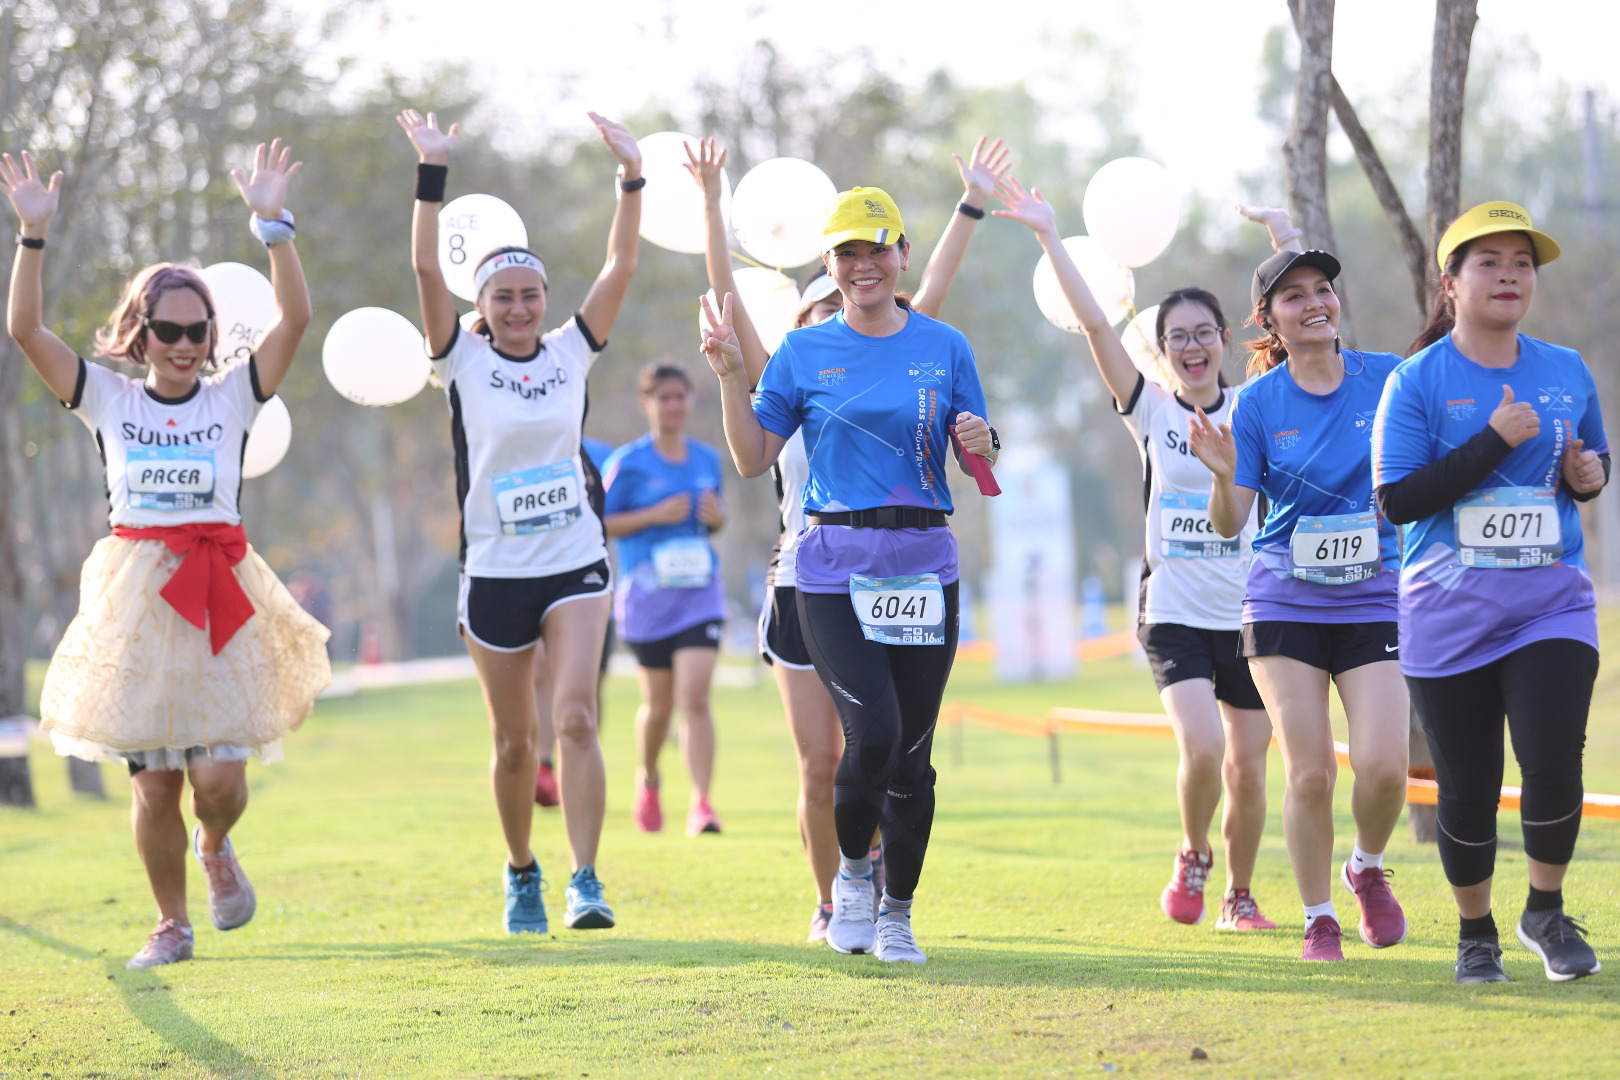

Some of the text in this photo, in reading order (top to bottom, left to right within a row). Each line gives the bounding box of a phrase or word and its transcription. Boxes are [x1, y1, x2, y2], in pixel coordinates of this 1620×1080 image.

[445, 213, 481, 231] ACE
[449, 233, 466, 265] 8
[228, 321, 264, 346] PAC
[818, 367, 847, 376] SINGHA
[918, 388, 926, 421] CROSS
[121, 421, 224, 447] SUUNTO
[1355, 420, 1366, 428] SP
[1553, 418, 1564, 457] CROSS
[140, 468, 201, 485] PACER
[512, 486, 568, 513] PACER
[1170, 517, 1213, 533] PACE
[1482, 512, 1543, 539] 6071
[1315, 535, 1363, 561] 6119
[1542, 553, 1553, 564] 16
[1363, 568, 1372, 578] 16
[871, 595, 927, 619] 6041
